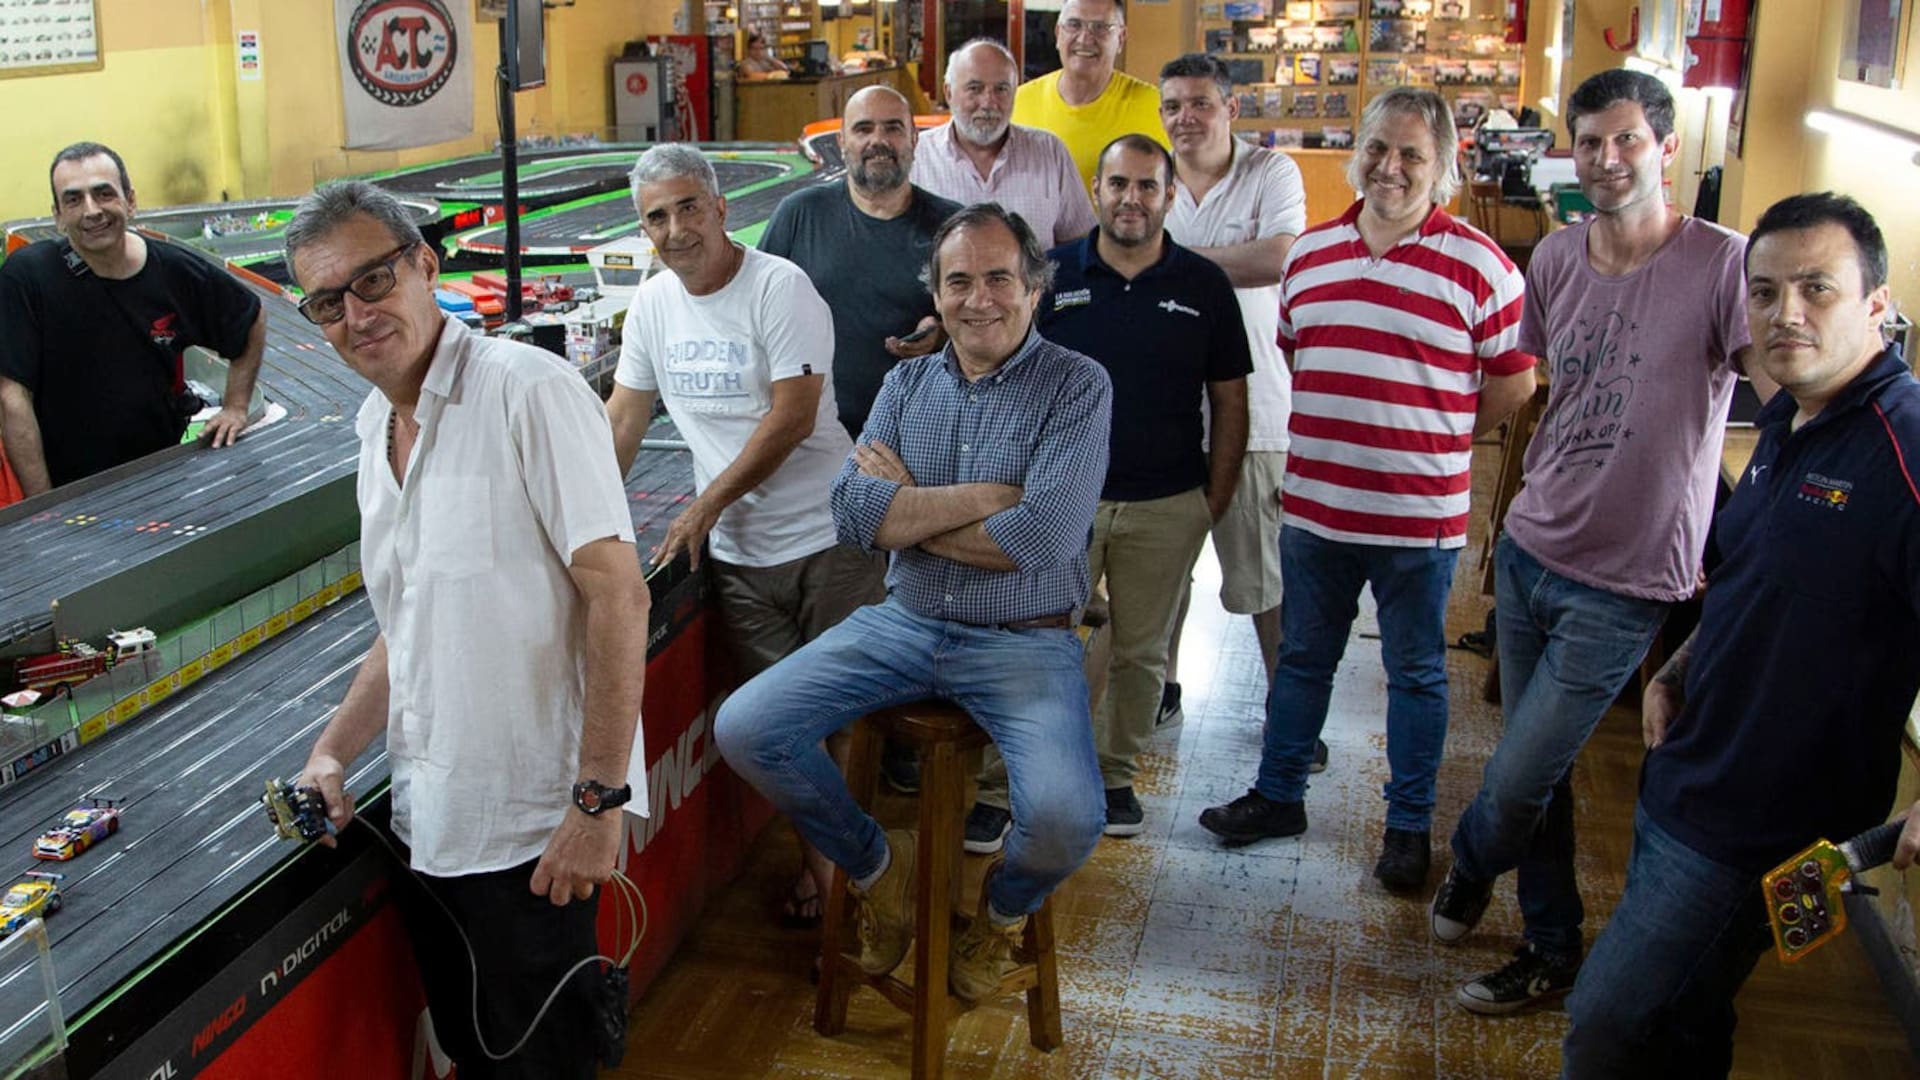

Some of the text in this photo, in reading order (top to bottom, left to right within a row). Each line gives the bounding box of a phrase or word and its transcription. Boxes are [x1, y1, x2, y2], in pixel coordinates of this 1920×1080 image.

[666, 340, 747, 368] HIDDEN
[668, 371, 742, 390] TRUTH
[191, 994, 247, 1058] NINCO
